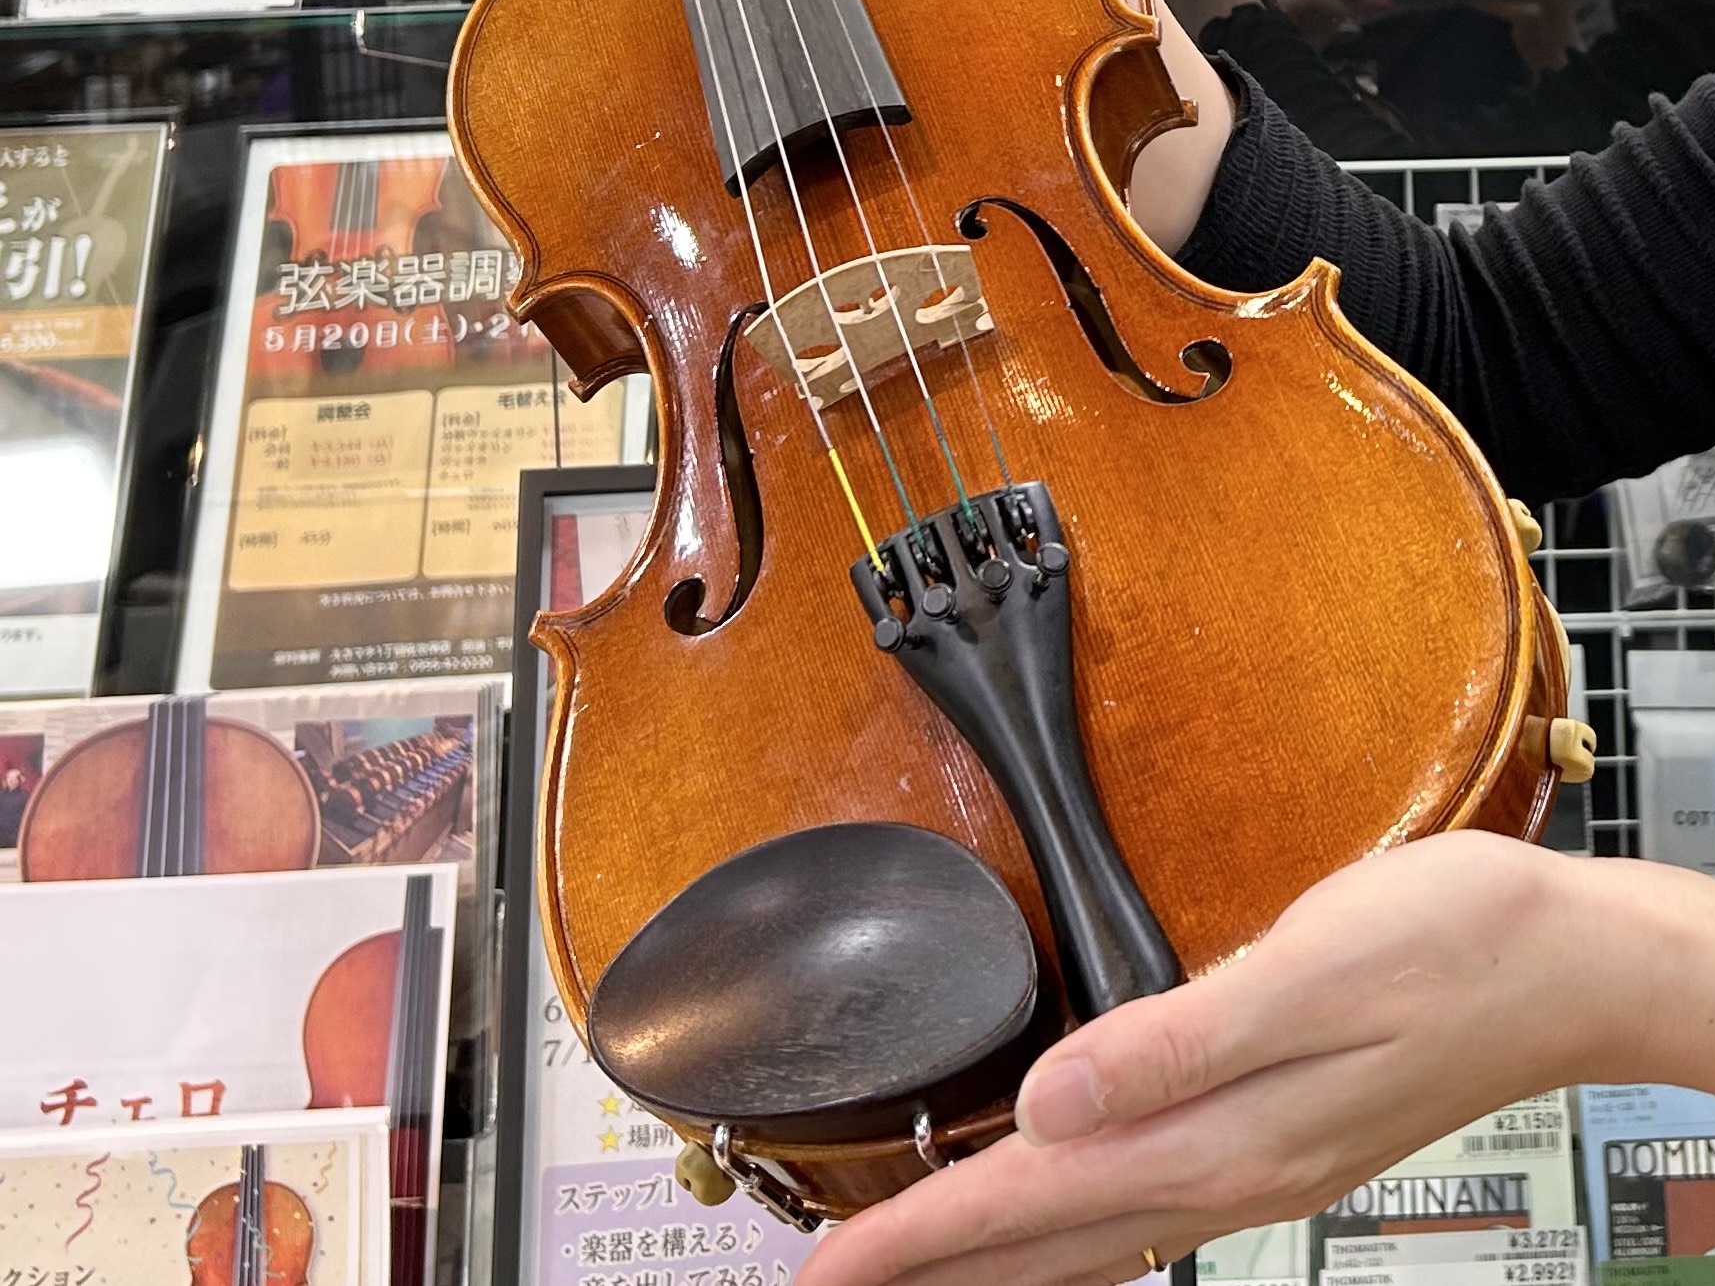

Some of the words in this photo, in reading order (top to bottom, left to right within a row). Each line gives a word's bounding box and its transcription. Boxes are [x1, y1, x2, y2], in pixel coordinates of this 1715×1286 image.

[40, 1078, 227, 1126] チェロ
[627, 1123, 674, 1148] 場所
[558, 1174, 674, 1211] ステップ1
